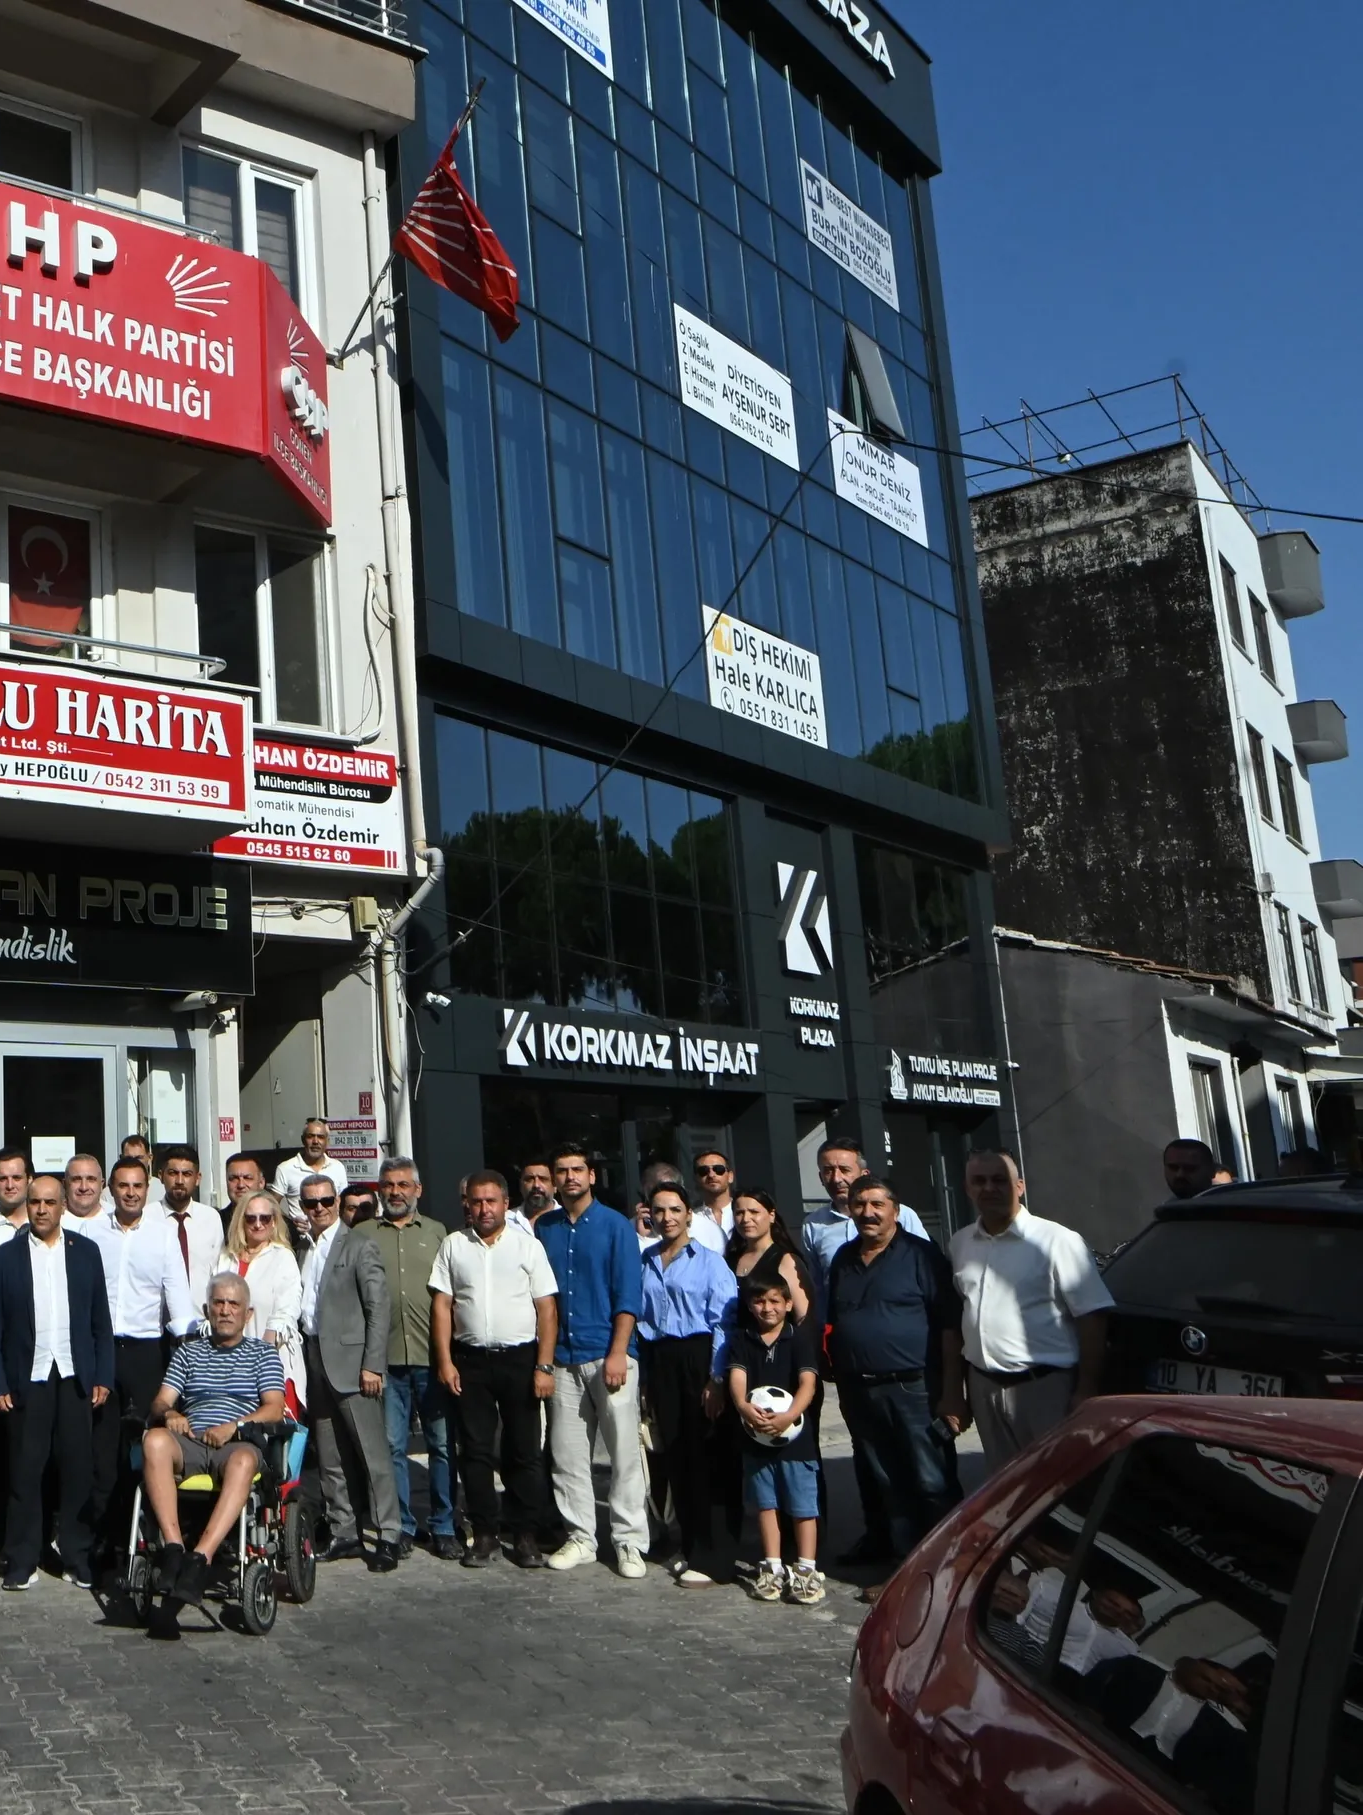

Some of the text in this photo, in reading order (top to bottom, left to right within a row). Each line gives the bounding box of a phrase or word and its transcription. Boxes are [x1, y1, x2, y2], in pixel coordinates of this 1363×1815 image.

[850, 239, 891, 284] BOZOĞLU
[33, 292, 115, 347] HALK
[125, 317, 234, 377] PARTİSİ
[687, 327, 710, 351] Sağlık
[689, 347, 716, 373] Meslek
[34, 347, 210, 421] BAŞKANLIĞI
[691, 367, 717, 392] Hizmet
[727, 364, 782, 410] DİYETİSYEN
[693, 386, 715, 409] Birimi
[722, 383, 791, 440] AYŞENUR SERT
[845, 451, 912, 503] ONUR DENİZ
[865, 483, 886, 505] PROJE
[733, 627, 812, 683] DİŞ HEKİMİ
[714, 655, 819, 720] Hale KARLICA
[55, 687, 232, 757] HARİTA
[740, 698, 819, 742] 0551 831 1453
[11, 738, 42, 751] Ltd.
[46, 740, 72, 756] Şti.
[15, 761, 88, 782] HEPOĞLU
[105, 772, 144, 790] 0542
[150, 776, 171, 793] 311
[177, 779, 195, 796] 53
[201, 782, 220, 799] 99
[259, 774, 327, 796] Mühendislik
[329, 783, 371, 800] Bürosu
[254, 801, 355, 819] omatik Mühendisi
[302, 817, 380, 845] Özdemir
[247, 842, 351, 862] 0545 515 62 60
[79, 876, 228, 930] PROJE
[789, 996, 840, 1020] KORKMAZ
[800, 1026, 836, 1047] PLAZA
[543, 1022, 673, 1070] KORKMAZ
[678, 1027, 759, 1086] İNŞAAT
[908, 1055, 936, 1074] TUTKU
[952, 1061, 973, 1078] PLAN
[973, 1063, 998, 1081] PROJE
[912, 1083, 936, 1101] AYKUT
[348, 1121, 374, 1129] HEPOĞLU
[1161, 1361, 1278, 1397] 10 YA 364
